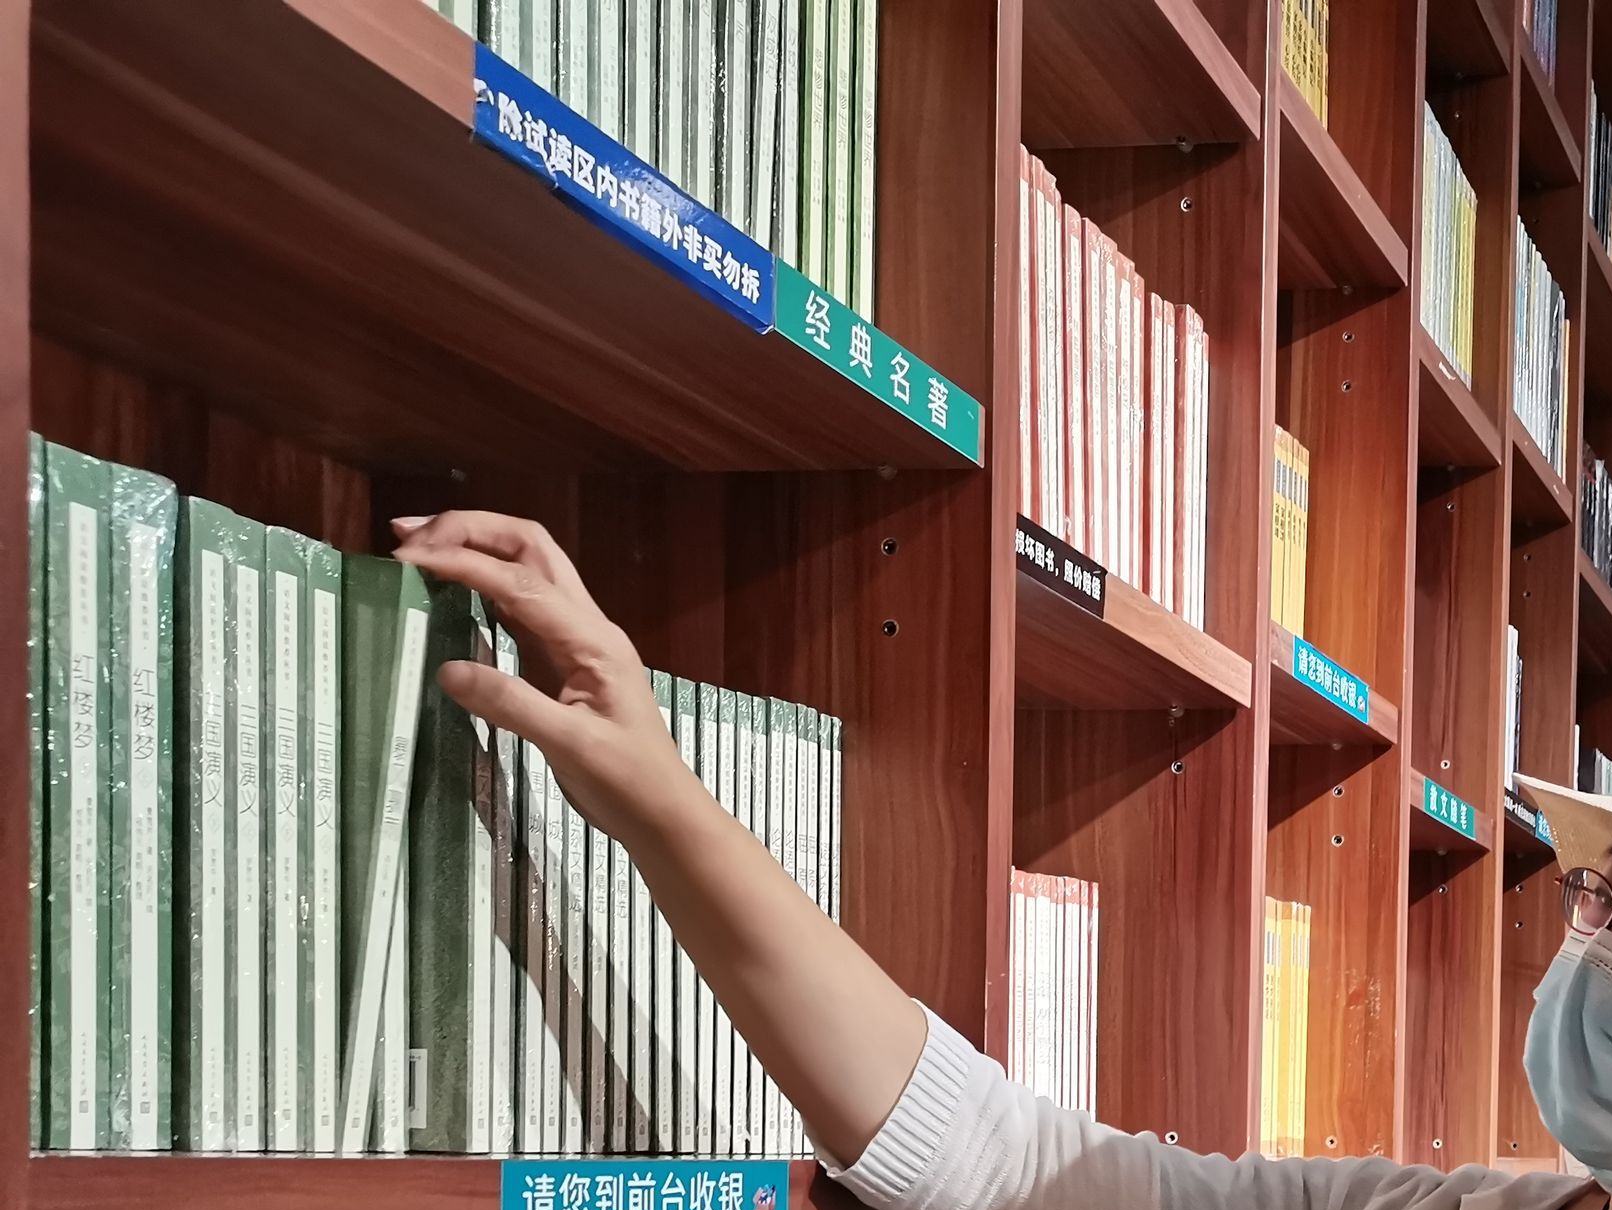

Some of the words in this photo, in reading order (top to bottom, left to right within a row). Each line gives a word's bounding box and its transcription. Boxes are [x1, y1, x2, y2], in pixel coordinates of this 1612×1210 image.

[497, 91, 761, 304] 除试读区内书籍外非买勿拆
[805, 289, 949, 430] 经典名著
[72, 653, 96, 748] 红楼梦
[133, 669, 156, 761] 红楼梦
[1297, 646, 1357, 709] 请您到前台收银
[239, 705, 260, 818] 三国演义
[278, 707, 299, 820] 三国演义
[315, 722, 335, 832] 三国演义
